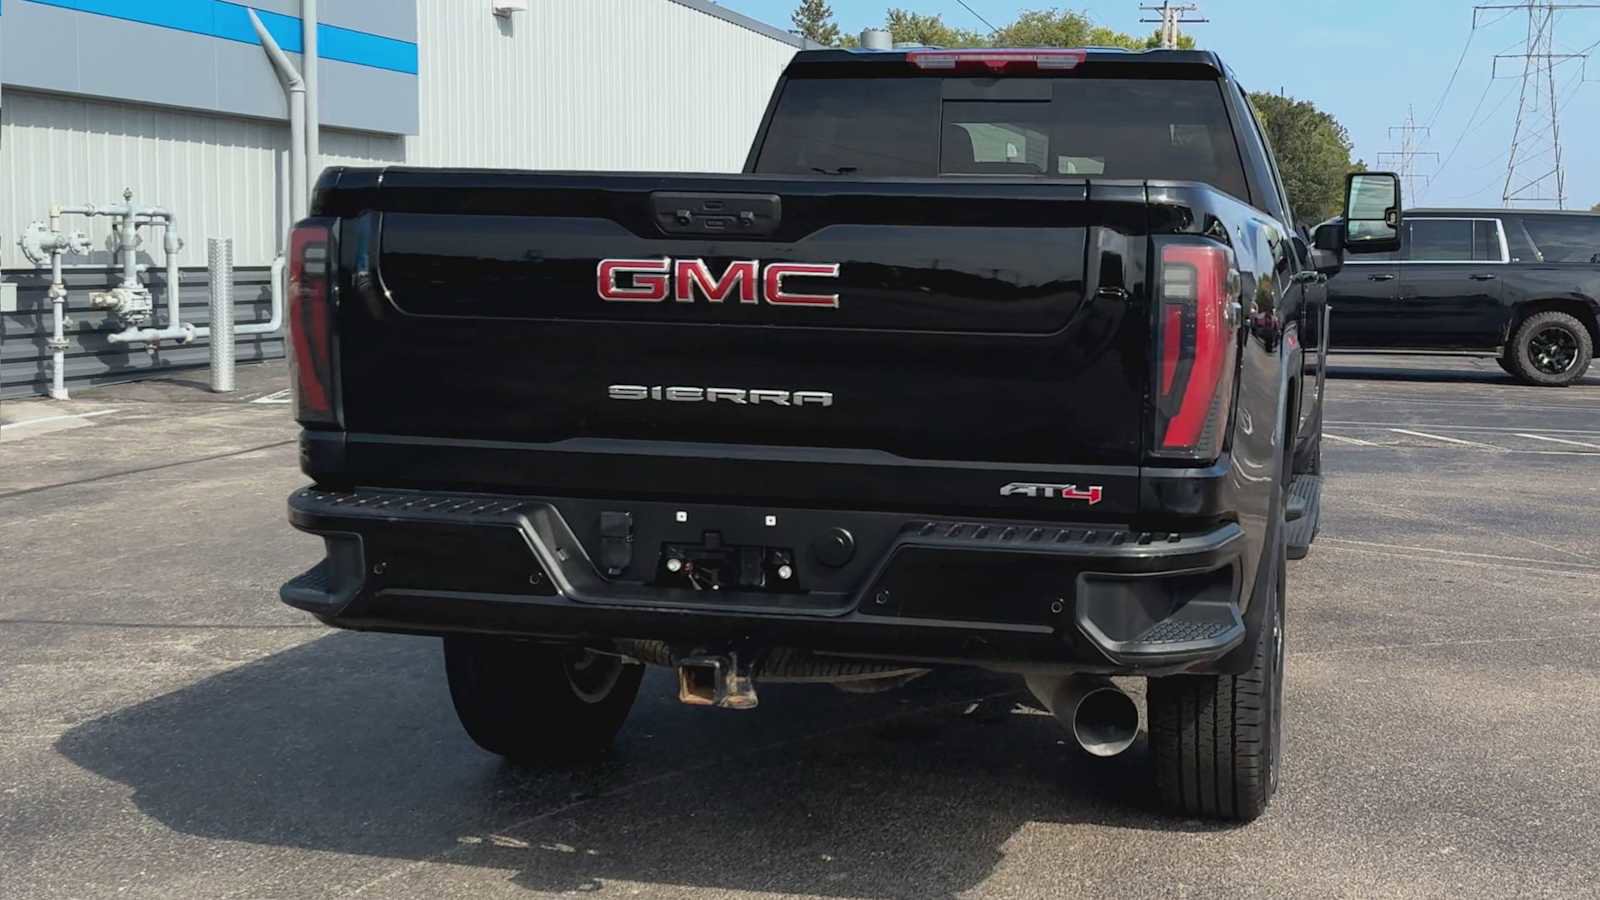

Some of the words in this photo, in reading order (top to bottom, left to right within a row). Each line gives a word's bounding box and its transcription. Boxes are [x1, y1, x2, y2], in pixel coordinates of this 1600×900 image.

[597, 256, 840, 308] GMC
[608, 385, 833, 406] SIERRA
[1000, 482, 1103, 505] AT4
